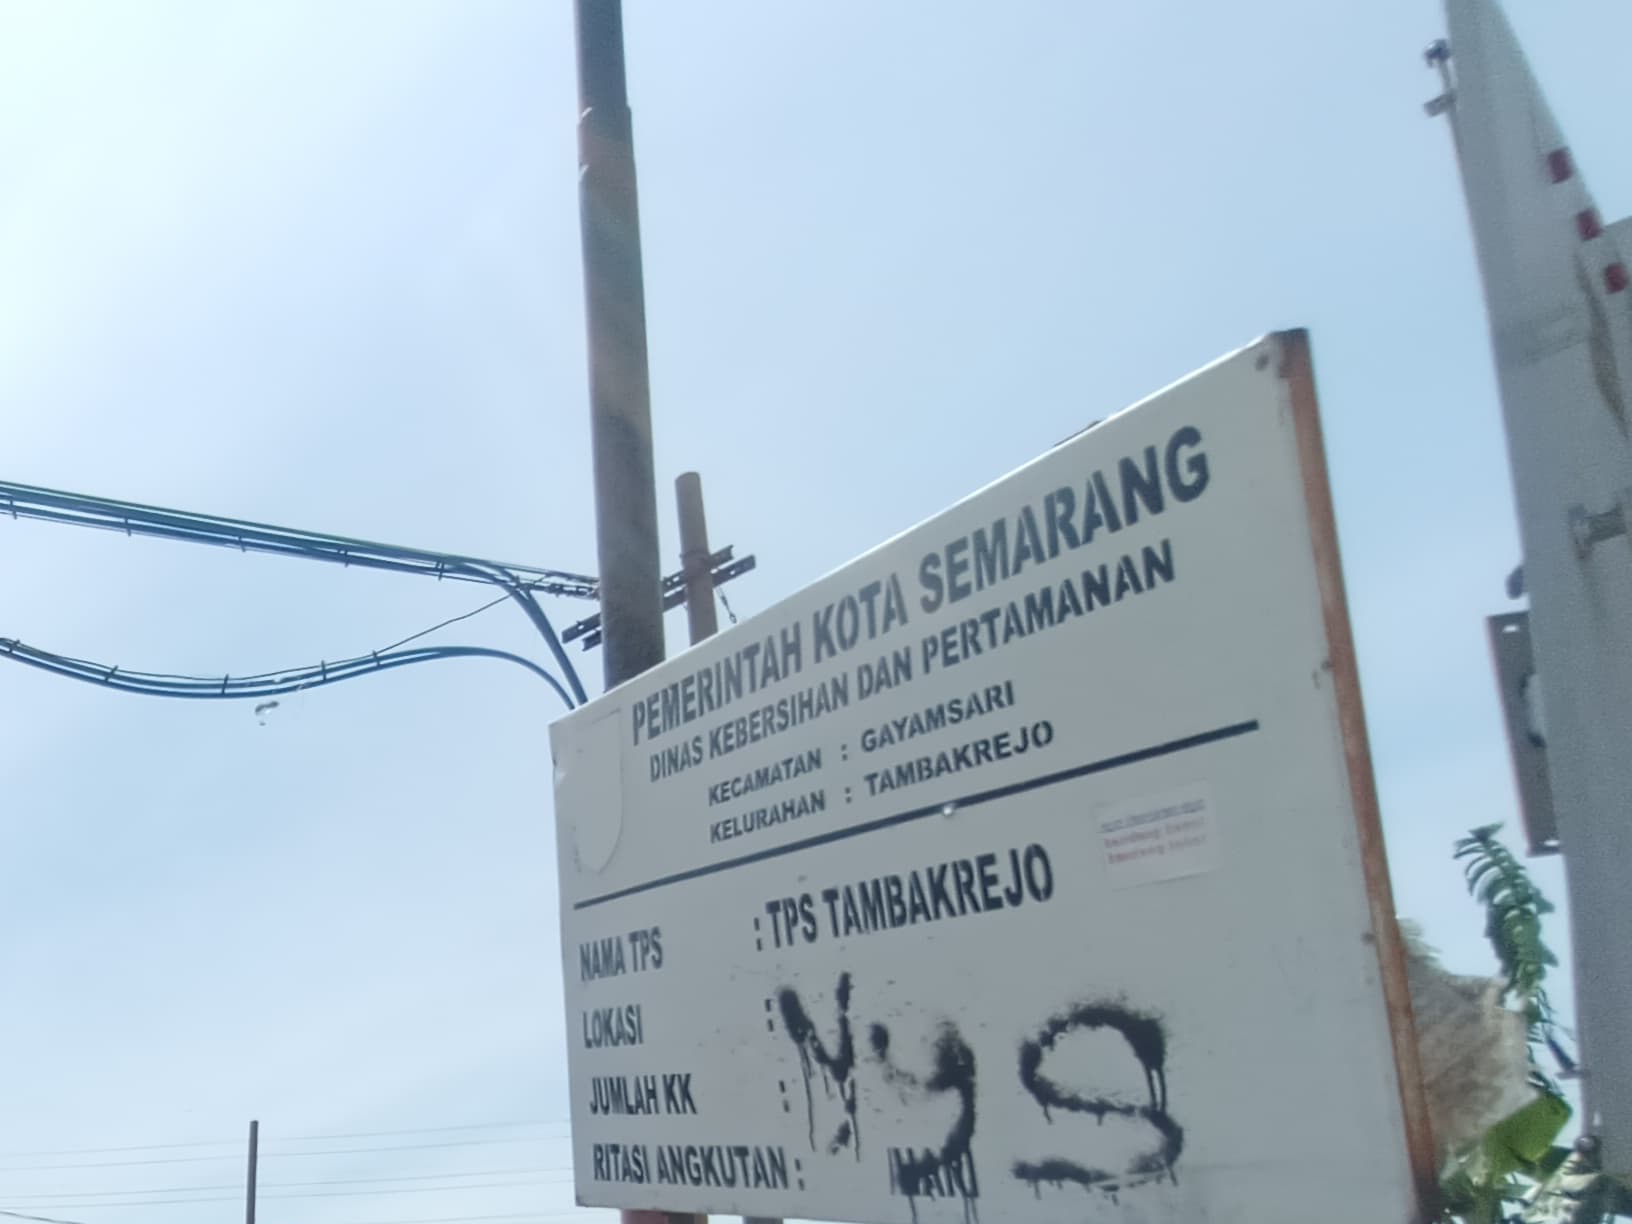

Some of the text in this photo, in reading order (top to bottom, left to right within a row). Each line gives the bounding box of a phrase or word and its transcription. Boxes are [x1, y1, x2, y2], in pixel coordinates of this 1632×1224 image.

[631, 425, 1210, 747] PEMERINTAH KOTA SEMARANG
[649, 537, 1176, 783] DINAS KEBERSIHAN DAN PERTAMANAN
[707, 747, 822, 807] KECAMATAN
[860, 679, 1016, 754] GAYAMSARI
[709, 789, 826, 844] KELURAHAN
[864, 719, 1055, 797] TAMBAKREJO
[579, 935, 626, 982] NAMA
[627, 925, 664, 973] TPS
[765, 892, 818, 949] TPS
[821, 842, 1055, 938] TAMBAKREJO
[582, 1003, 644, 1049] LOKASI
[589, 1074, 659, 1116] JUMLAH
[661, 1072, 699, 1115] KK
[591, 1142, 651, 1184] RITASI
[656, 1145, 790, 1190] ANGKUTAN
